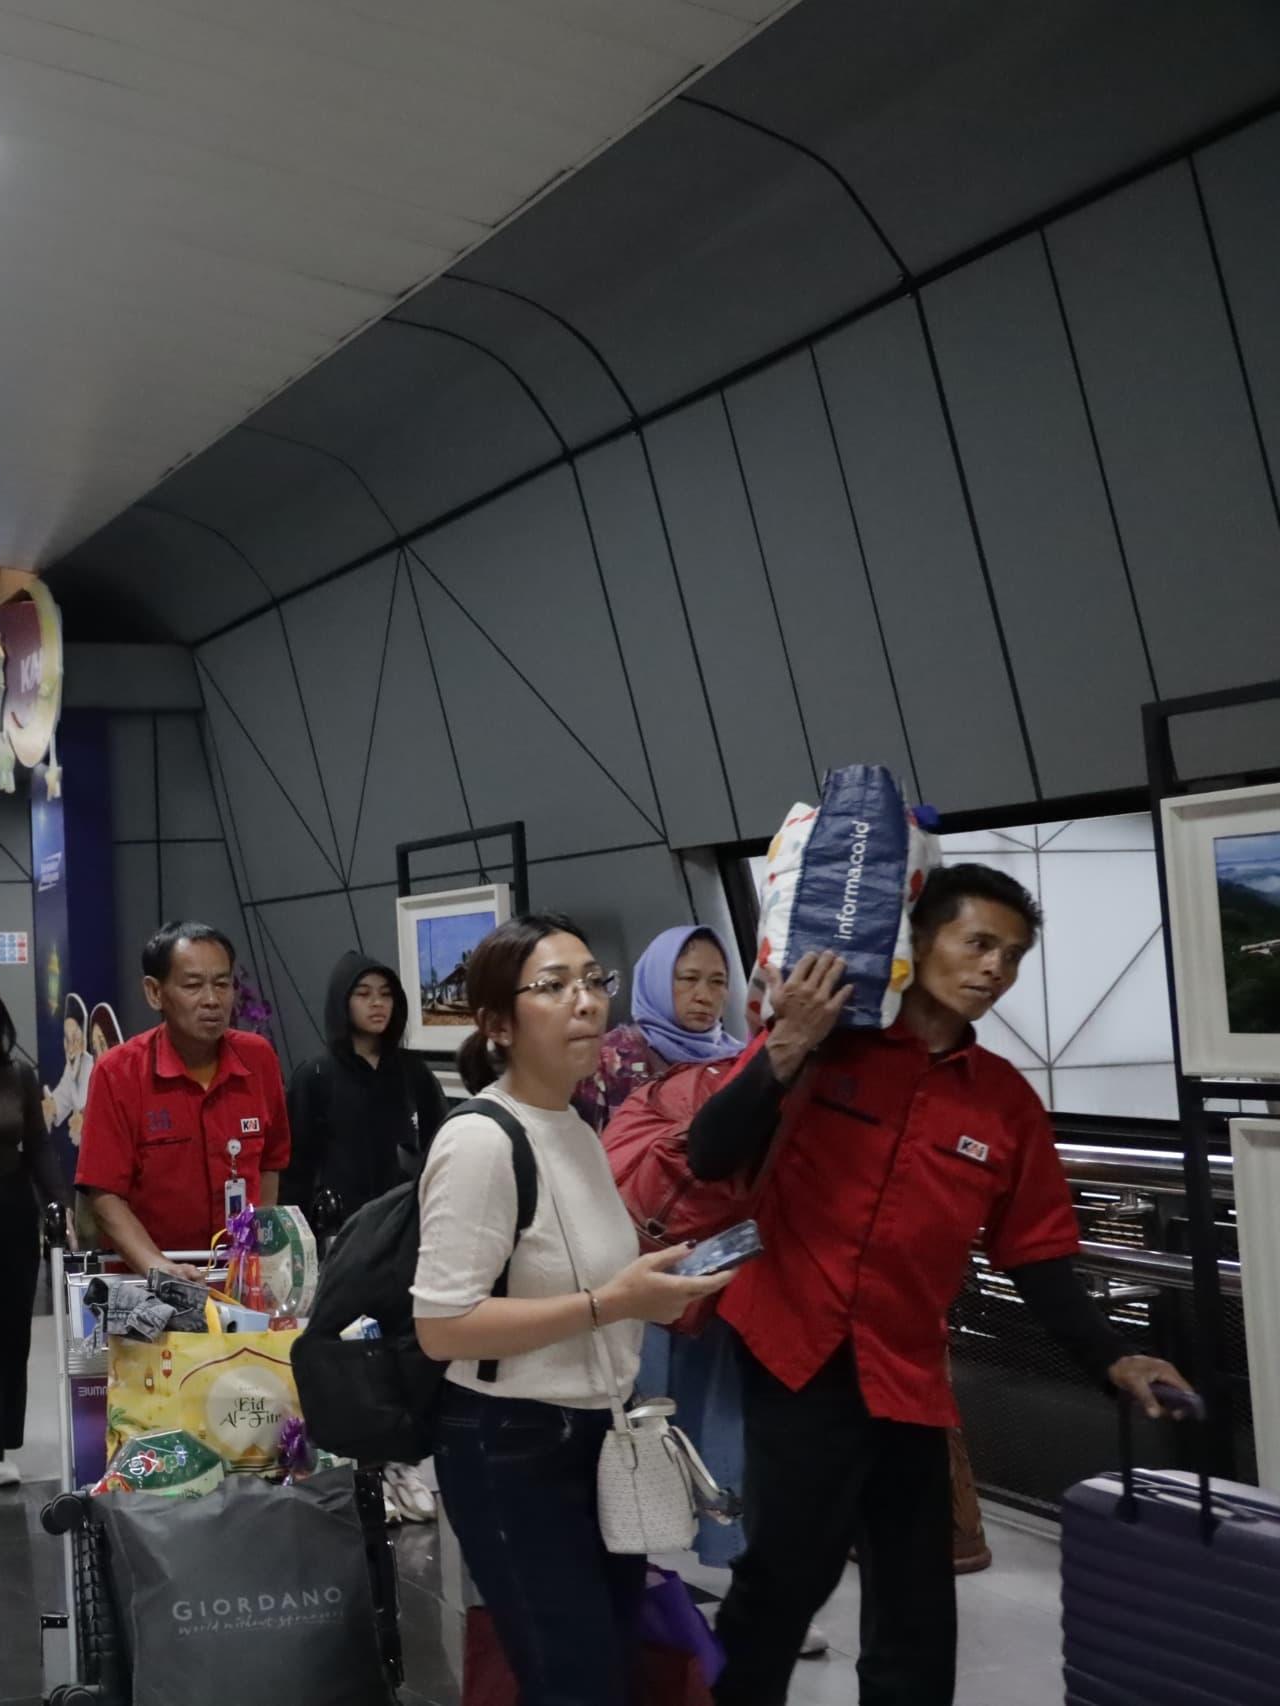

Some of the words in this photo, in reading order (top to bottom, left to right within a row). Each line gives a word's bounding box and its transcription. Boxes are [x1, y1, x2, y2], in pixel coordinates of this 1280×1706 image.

[834, 820, 869, 941] informa.co.id
[236, 1396, 265, 1412] Eid
[172, 1586, 342, 1621] GIORDANO
